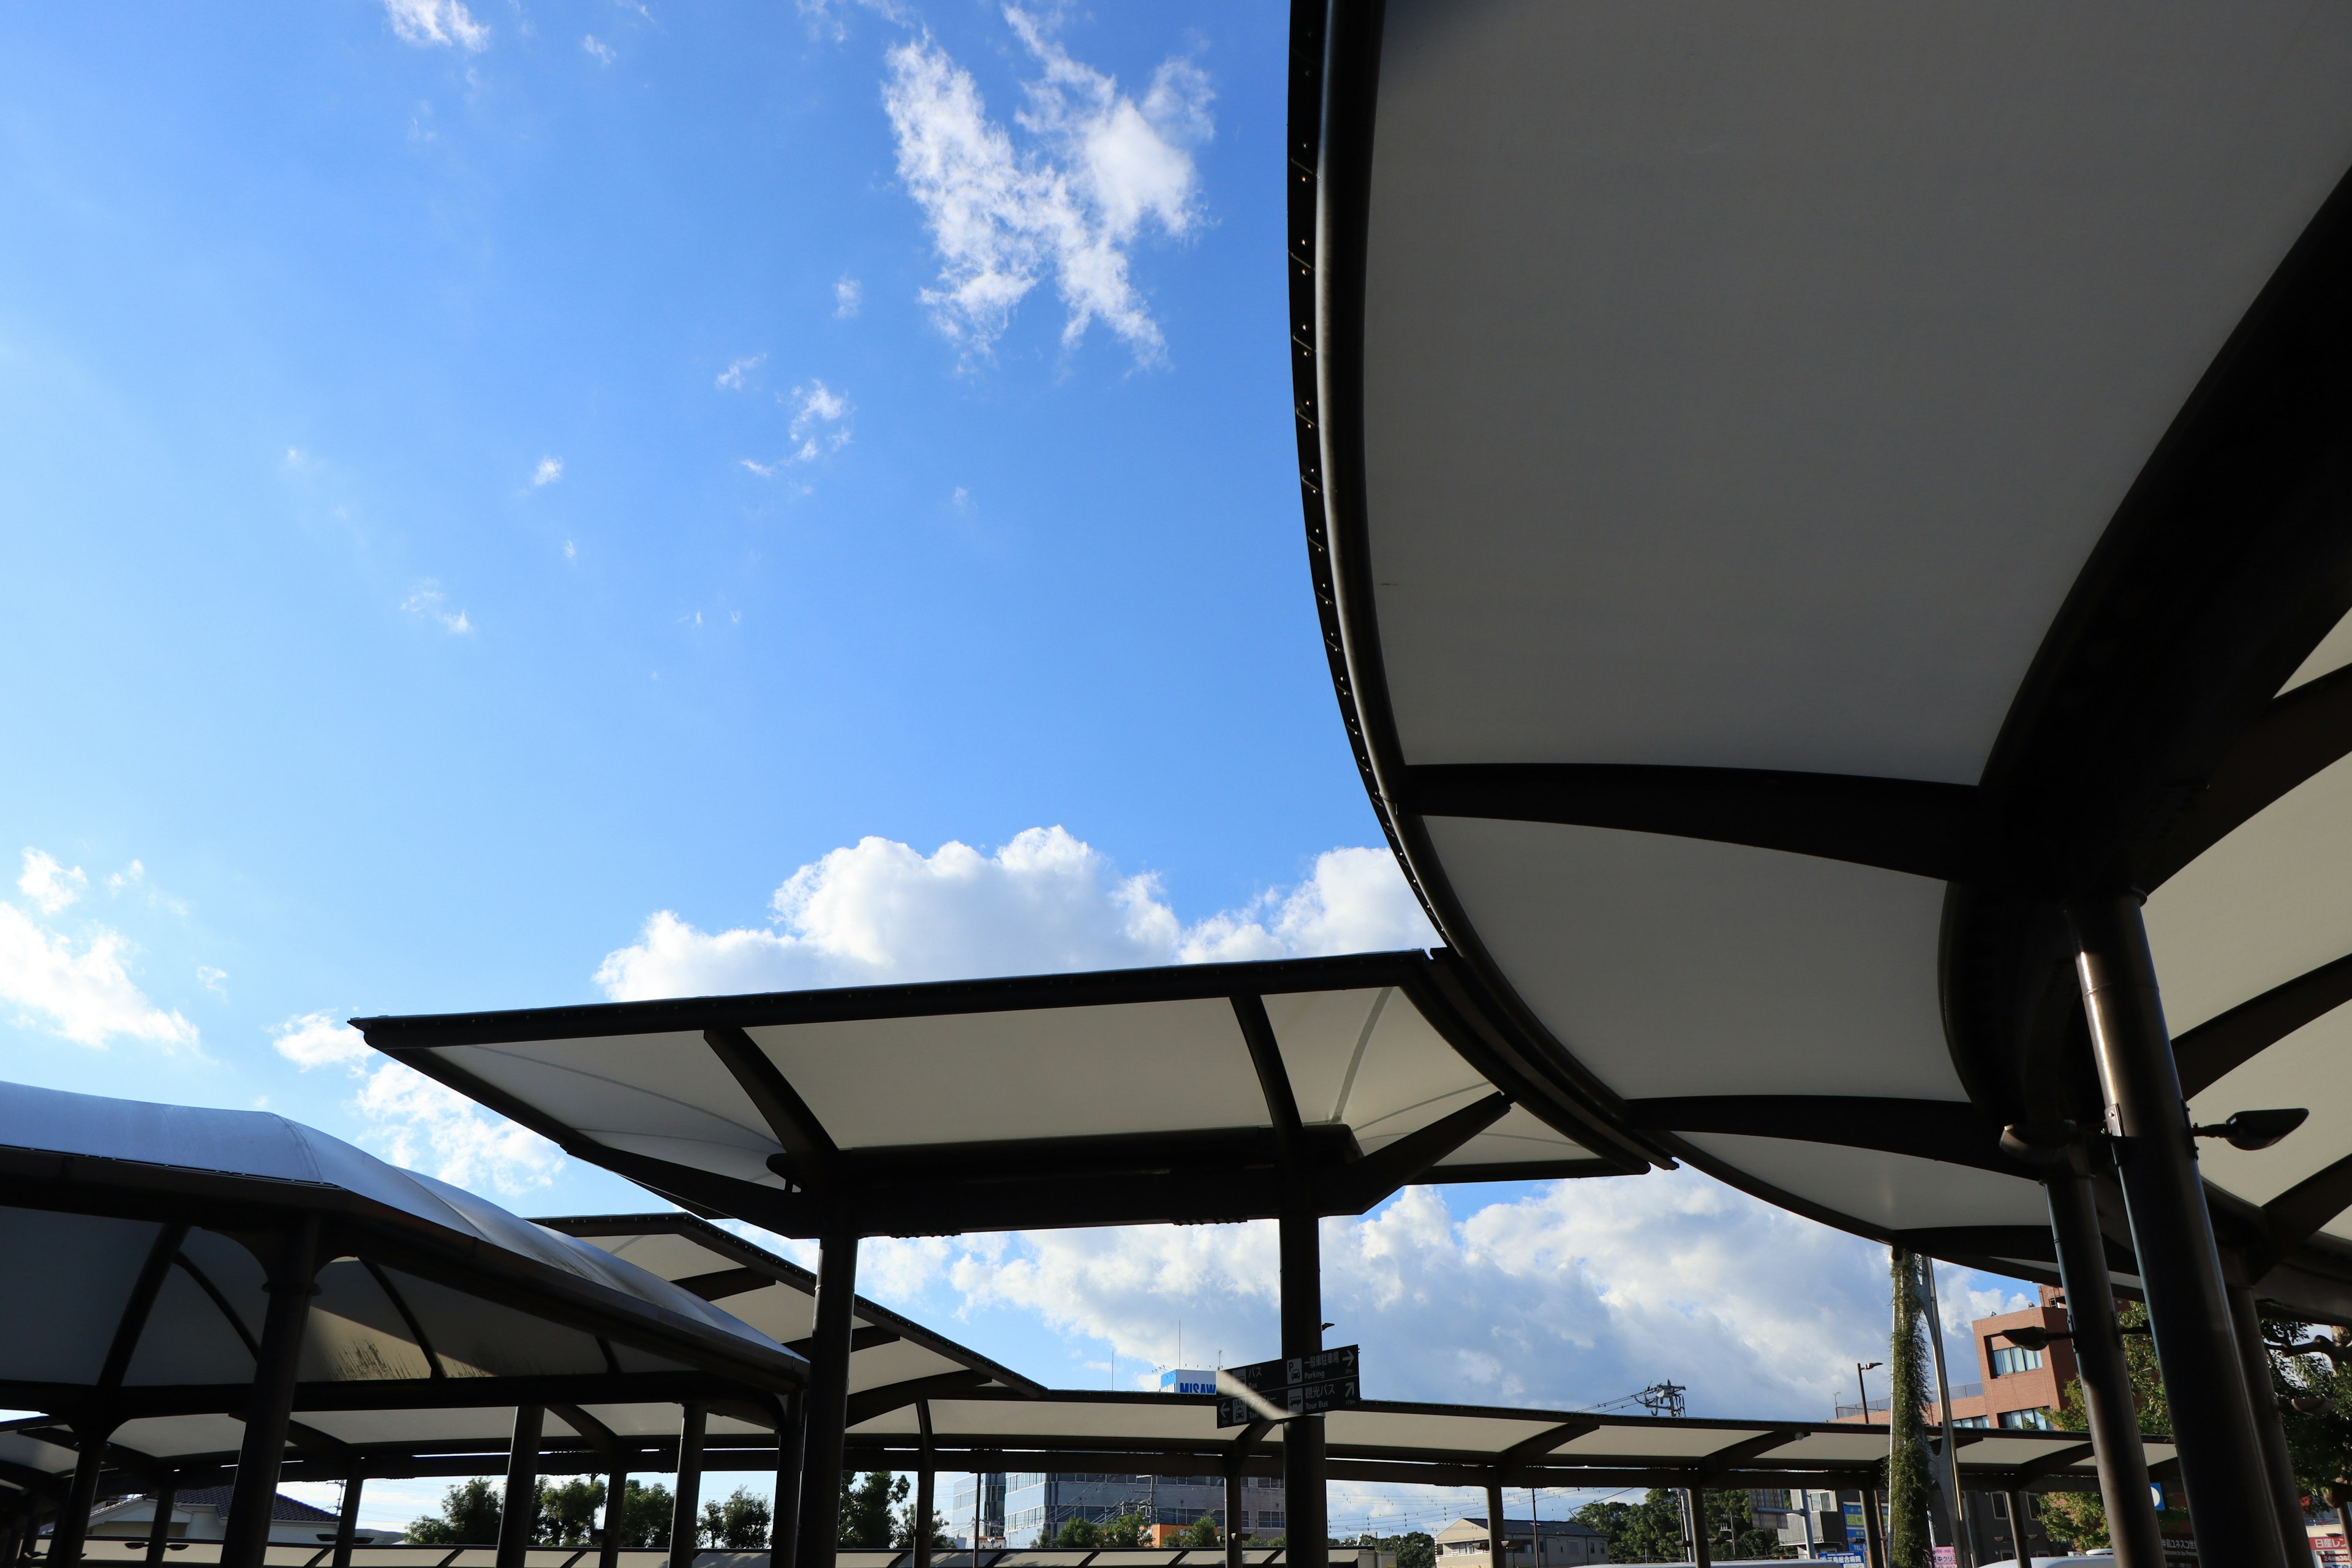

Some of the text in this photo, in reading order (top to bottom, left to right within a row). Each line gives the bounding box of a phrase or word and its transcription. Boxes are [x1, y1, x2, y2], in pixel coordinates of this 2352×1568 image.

[1303, 1351, 1340, 1368] 一般車駐車場
[1248, 1366, 1262, 1378] バス
[1304, 1371, 1325, 1379] Parking
[1305, 1383, 1335, 1400] 観光バス
